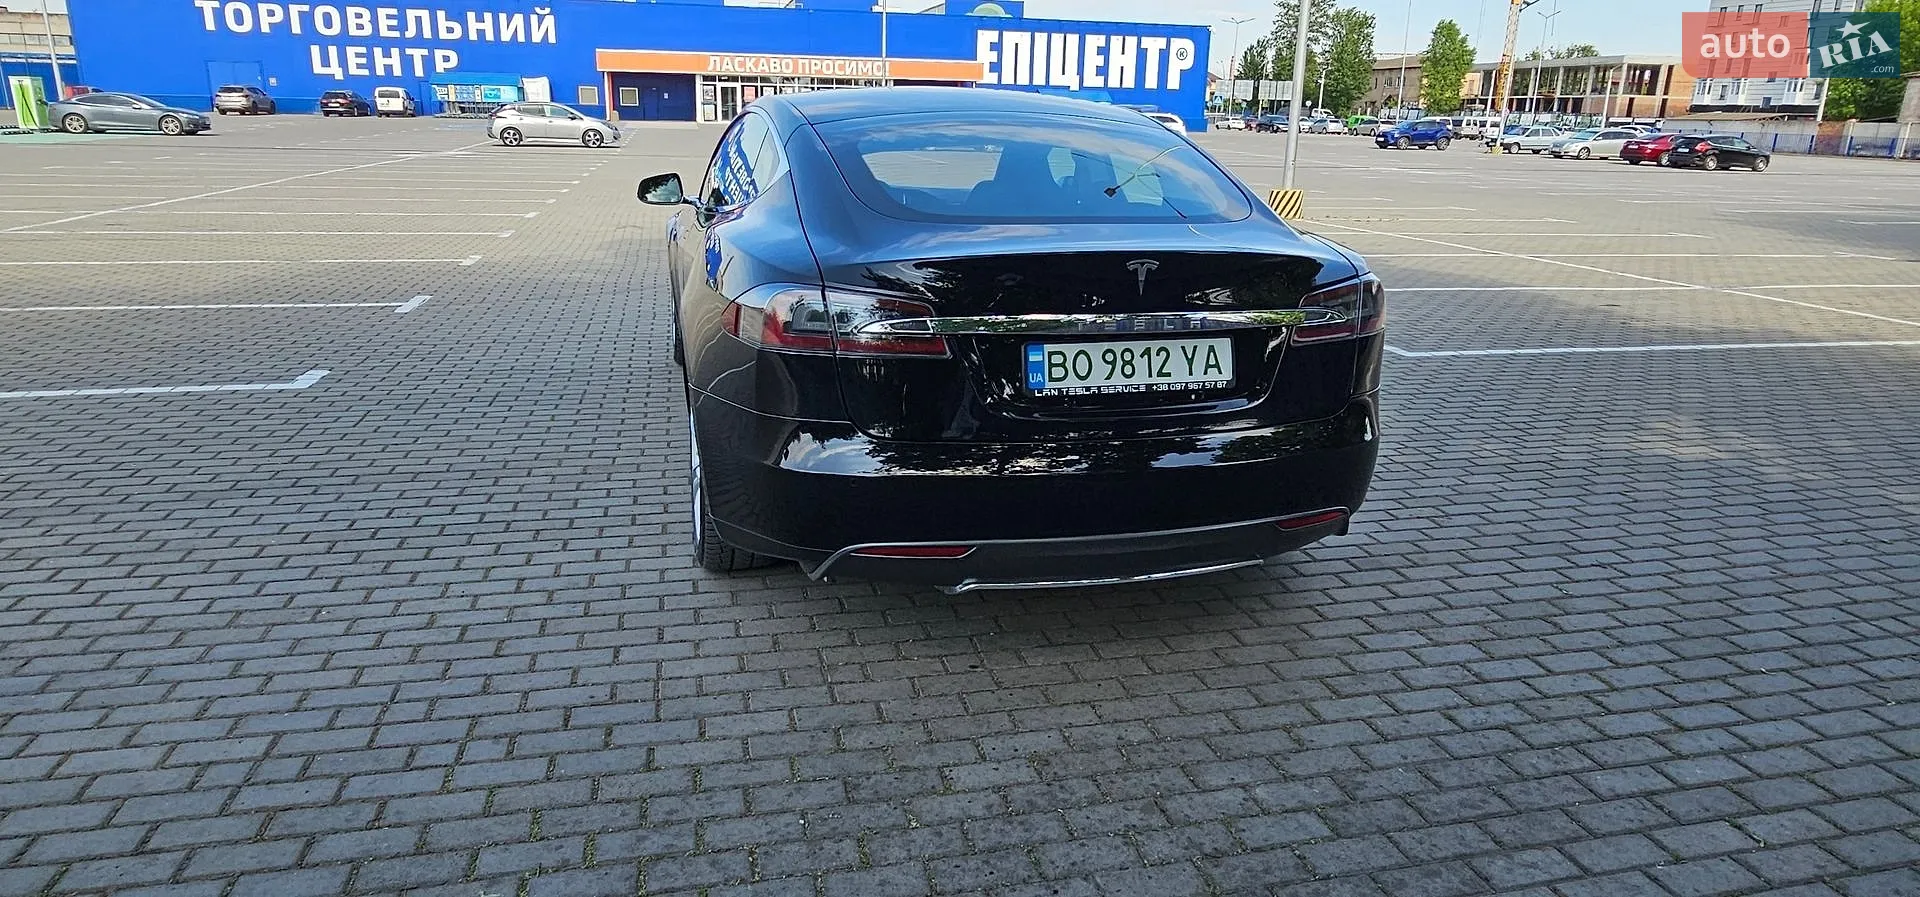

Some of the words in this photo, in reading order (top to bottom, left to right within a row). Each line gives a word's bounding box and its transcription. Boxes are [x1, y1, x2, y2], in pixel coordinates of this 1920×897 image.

[194, 0, 558, 44] ТОРГОВЕЛЬНИЙ
[309, 44, 459, 80] ЦЕНТР
[708, 56, 793, 73] ЛАСКАВО
[976, 29, 1195, 91] ЕПІЦЕНТР
[1029, 372, 1043, 383] UA
[1047, 349, 1093, 383] BO
[1101, 346, 1172, 380] 9812
[1180, 344, 1223, 377] YA
[1034, 388, 1058, 397] LAN
[1061, 387, 1098, 396] TESLA
[1101, 384, 1146, 394] SERVICE
[1170, 383, 1186, 391] 097
[1204, 381, 1216, 389] 57
